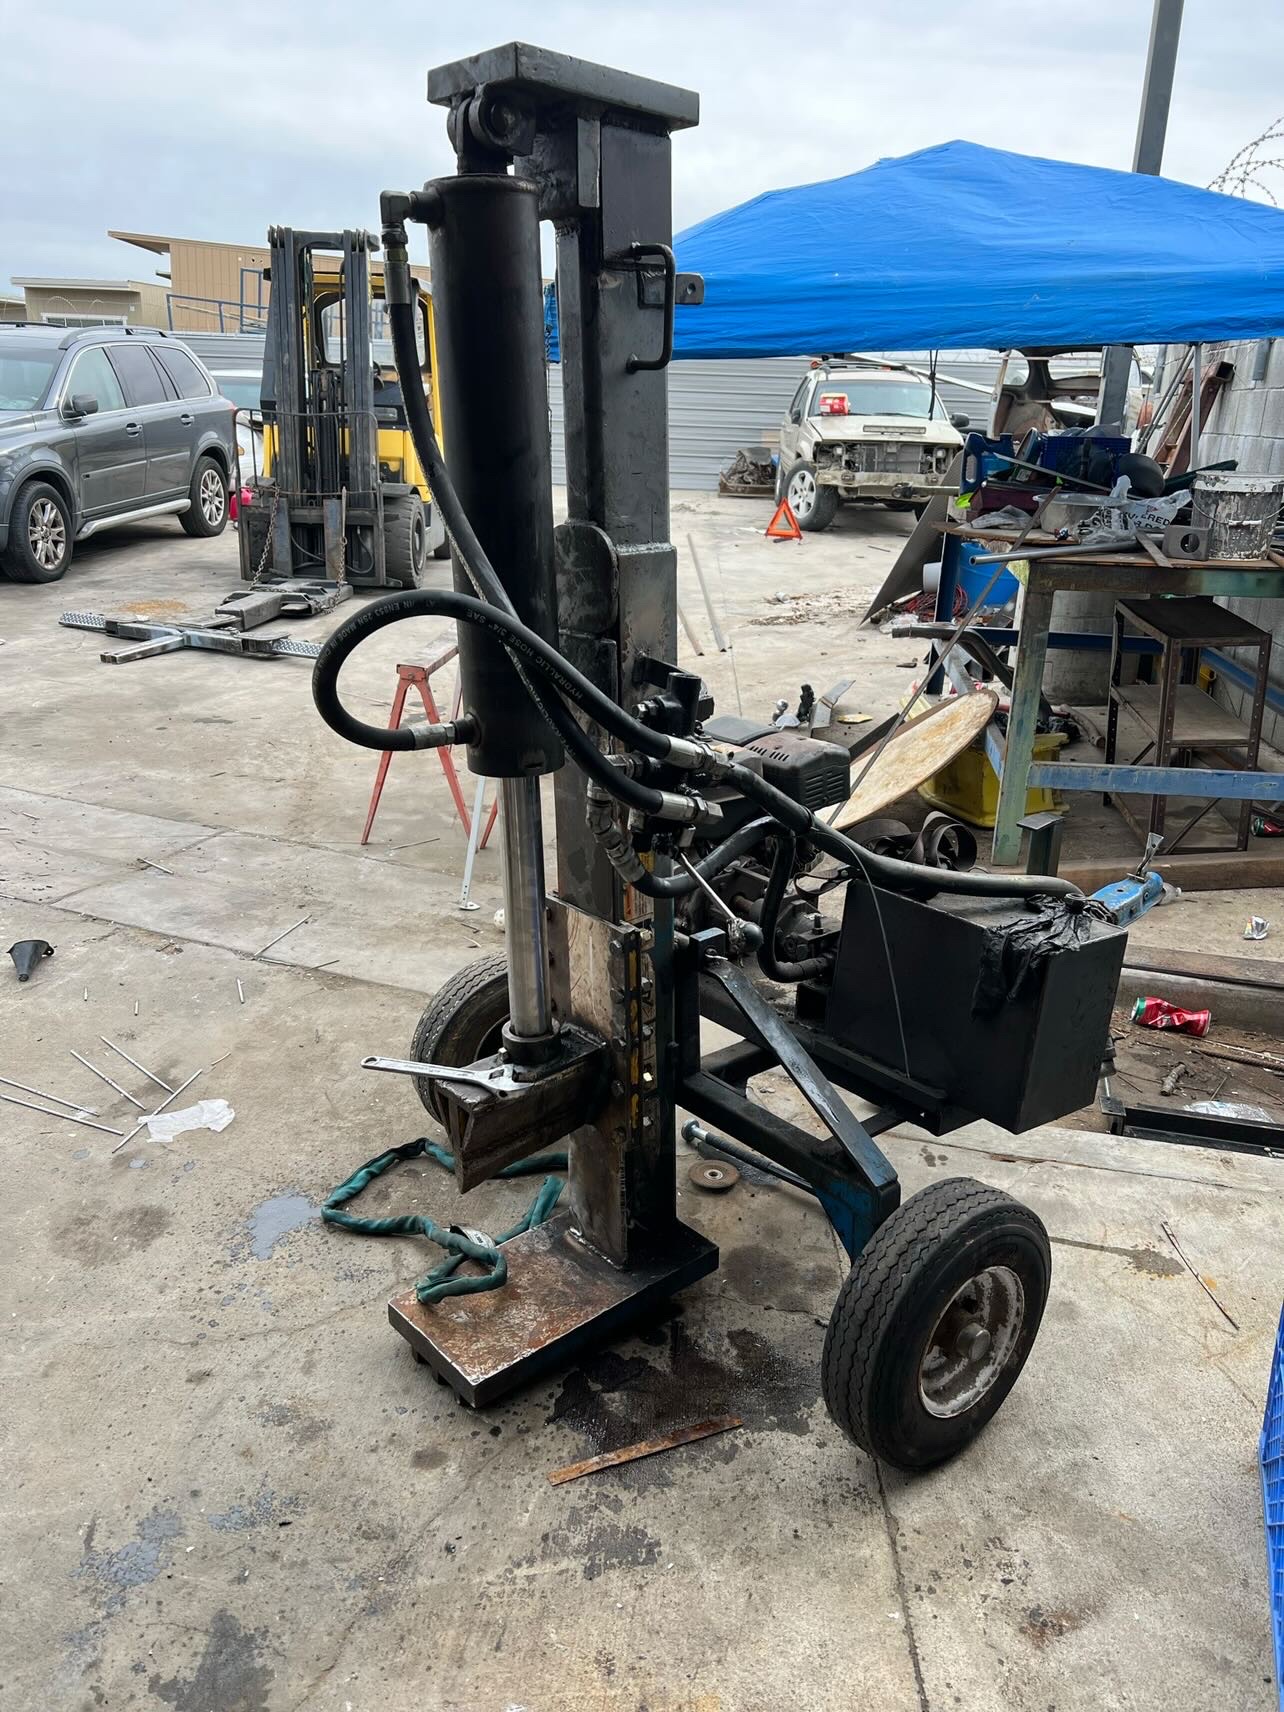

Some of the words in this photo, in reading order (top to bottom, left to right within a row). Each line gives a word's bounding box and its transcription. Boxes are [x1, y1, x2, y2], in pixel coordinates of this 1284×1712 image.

[465, 608, 487, 624] SAE
[338, 621, 357, 641] MADE
[509, 634, 535, 657] HOSE
